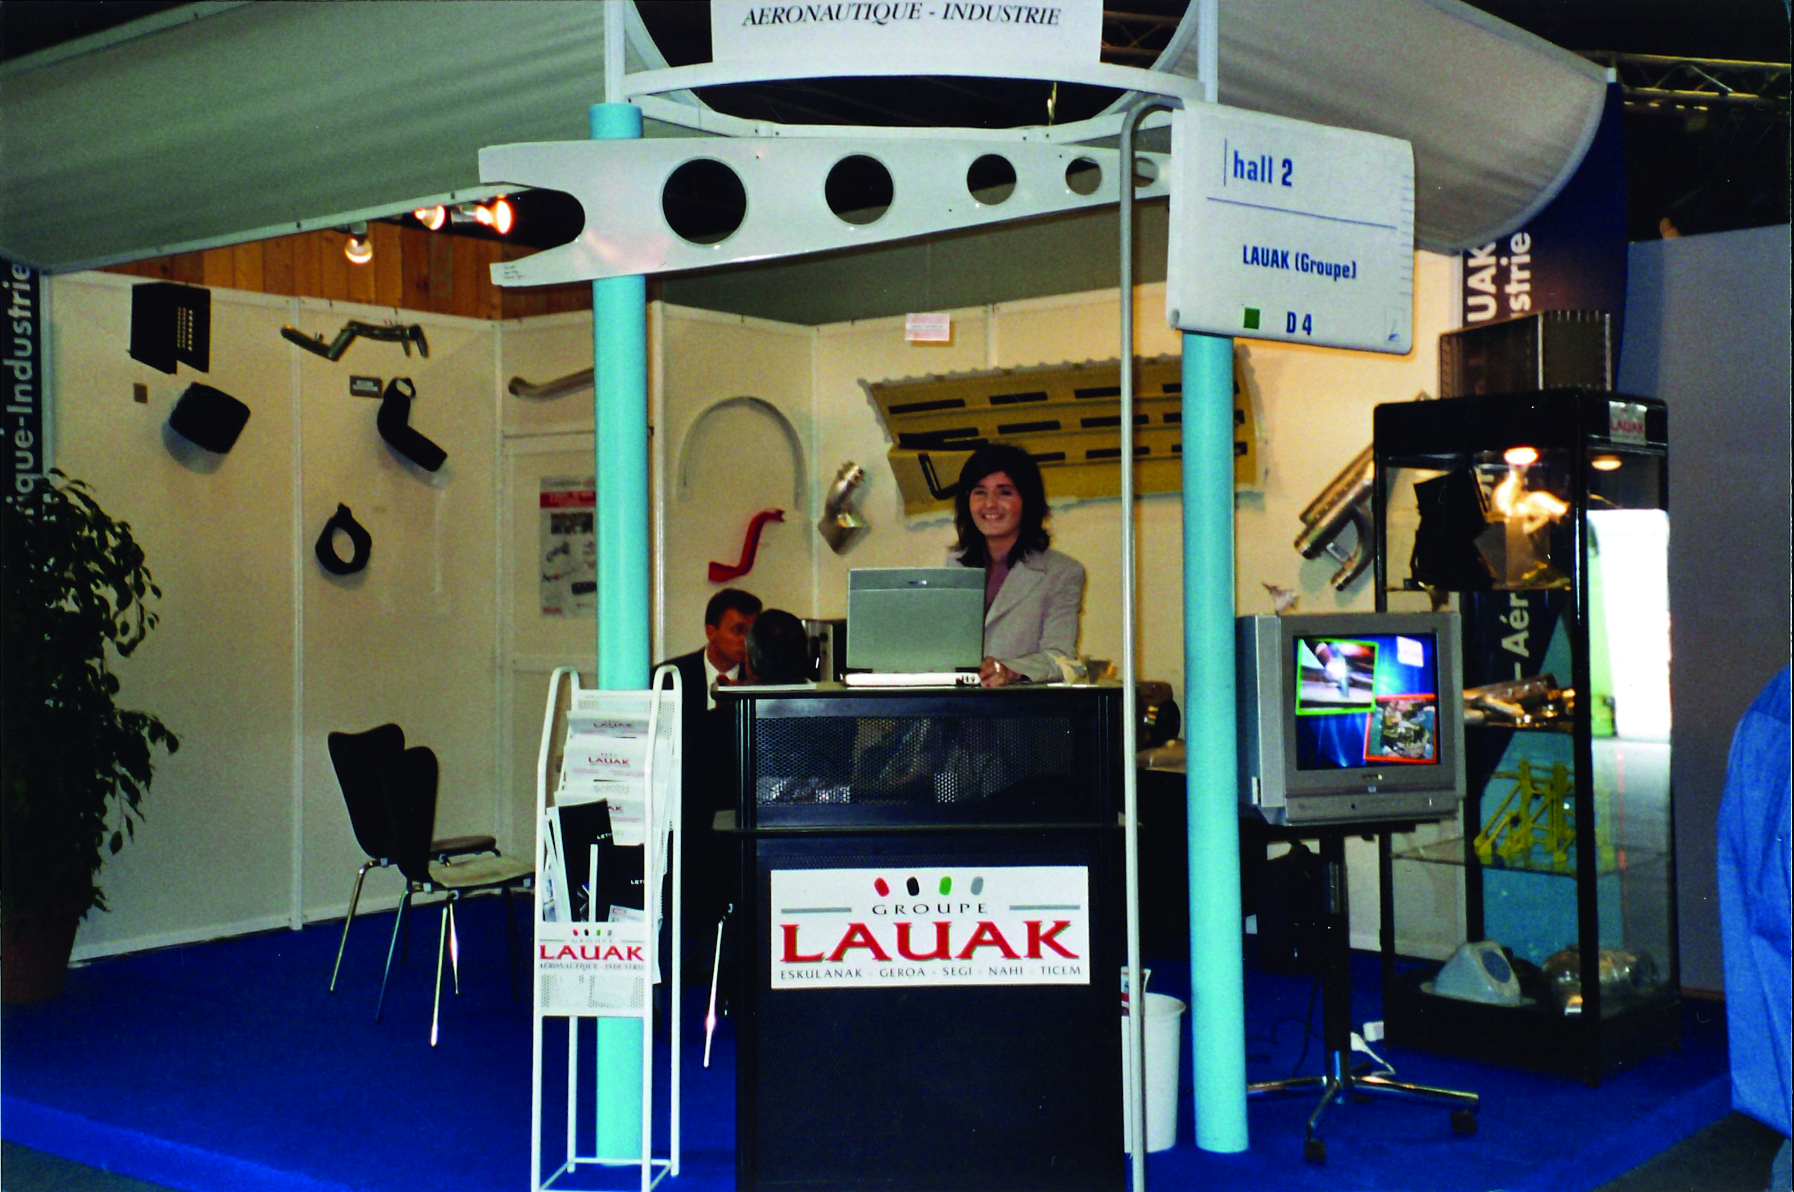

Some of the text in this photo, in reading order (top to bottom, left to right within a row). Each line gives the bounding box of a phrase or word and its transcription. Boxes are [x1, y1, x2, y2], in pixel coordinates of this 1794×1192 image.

[742, 1, 922, 26] AERONAUTIQUE
[942, 1, 1062, 26] INDUSTRIE
[1233, 149, 1294, 187] hall 2
[1242, 244, 1358, 282] LAUAK (Groupe)
[1286, 311, 1313, 336] D 4
[588, 756, 630, 766] LAUAK
[872, 902, 989, 916] GROUPE
[540, 944, 645, 962] LAUAK
[780, 919, 1081, 963] LAUAK
[780, 967, 863, 980] ESKULANAK
[879, 967, 926, 978] GEROA
[942, 966, 973, 977] SEGI
[988, 966, 1024, 976] NAHI
[1041, 965, 1082, 976] TICEM
